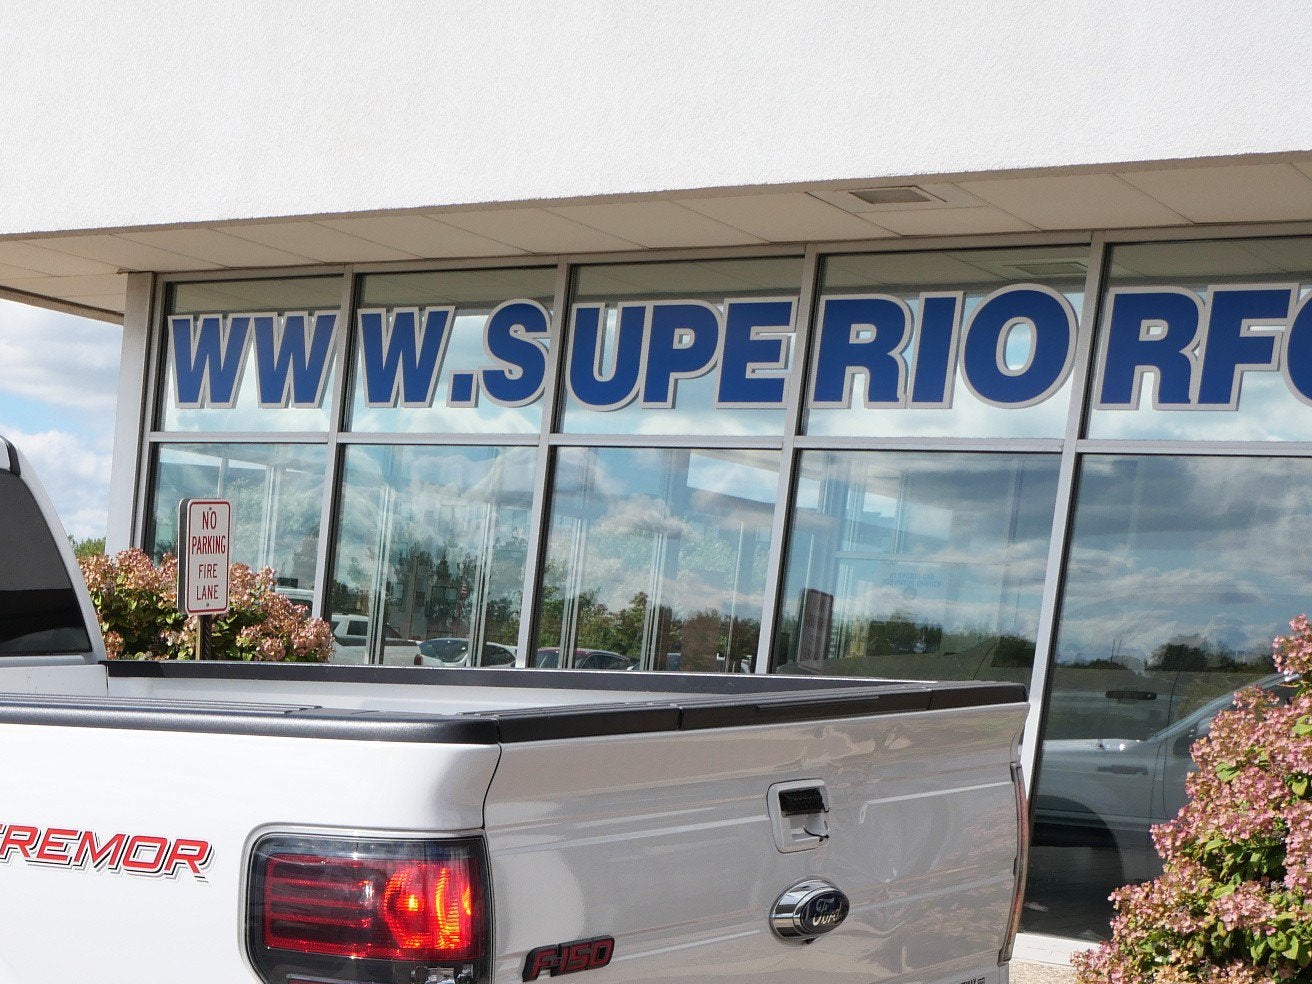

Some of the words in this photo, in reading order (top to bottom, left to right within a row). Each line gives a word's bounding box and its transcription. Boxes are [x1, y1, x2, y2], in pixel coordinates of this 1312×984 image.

[167, 283, 1312, 413] WWW.SUPERIORF
[202, 510, 217, 530] NO
[191, 535, 226, 555] PARKING
[198, 563, 218, 579] FIRE
[196, 584, 219, 601] LANE
[811, 897, 844, 927] Ford
[527, 936, 614, 980] F-150
